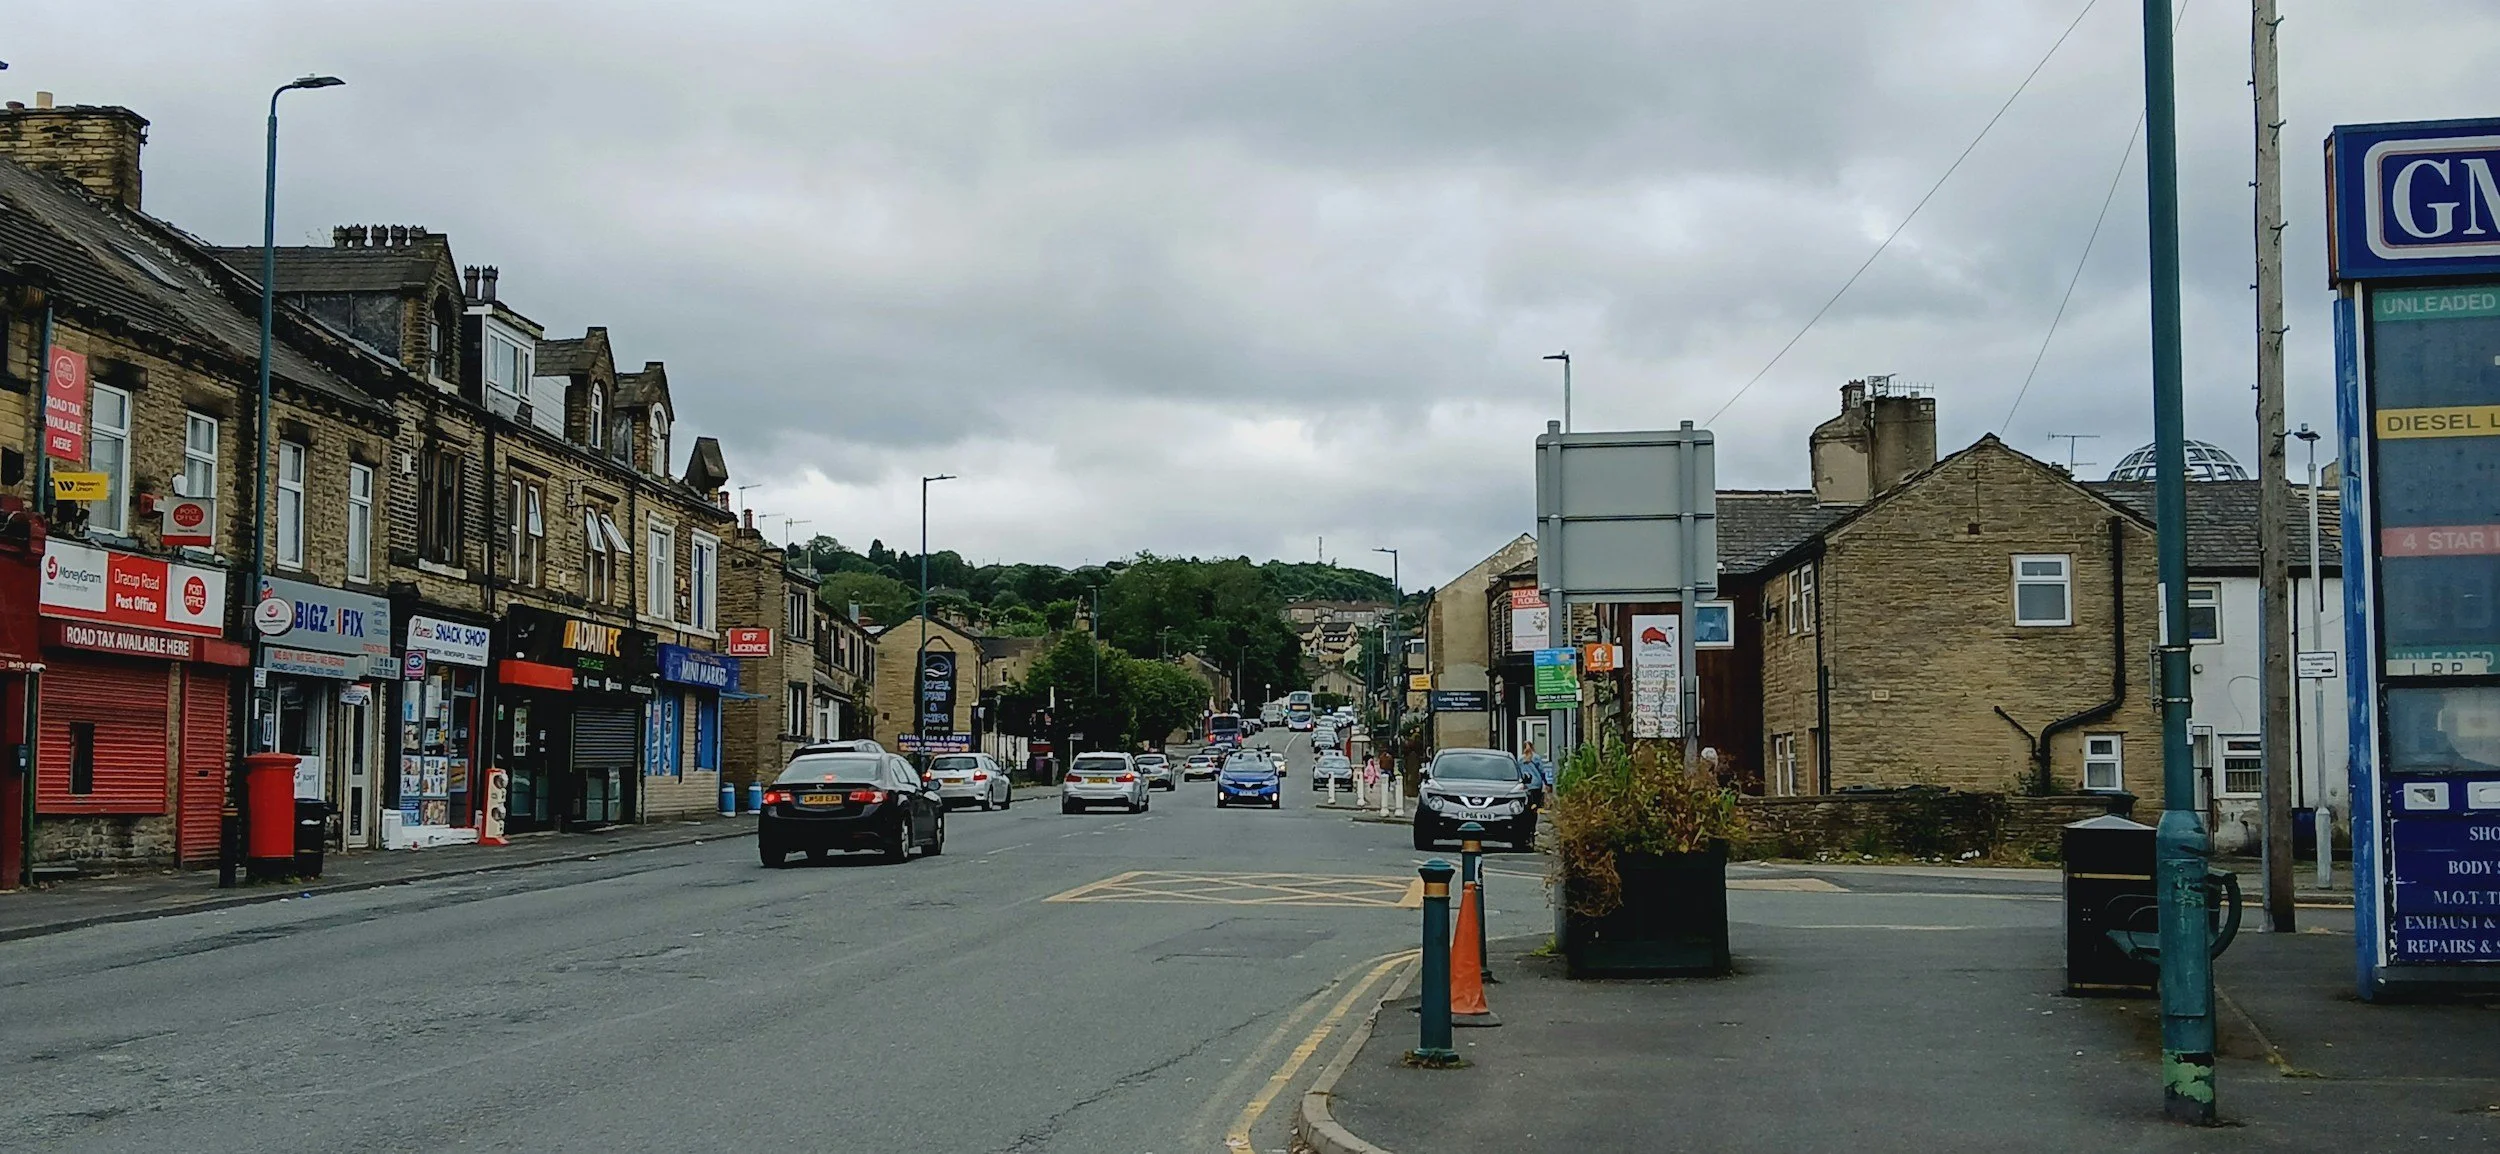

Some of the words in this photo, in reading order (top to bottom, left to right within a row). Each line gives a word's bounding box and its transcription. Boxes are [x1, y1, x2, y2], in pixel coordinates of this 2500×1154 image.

[2383, 293, 2496, 314] UNLEADED
[46, 395, 67, 412] ROAD
[68, 401, 81, 417] TAX
[2387, 414, 2481, 432] DIESEL
[52, 435, 72, 452] HERE
[2402, 533, 2418, 550] 4
[2428, 531, 2485, 550] STAR
[59, 566, 102, 584] MoneyGram
[114, 568, 140, 590] Dracup
[141, 574, 160, 591] Road
[187, 583, 203, 595] POST
[115, 593, 135, 609] Post
[134, 596, 158, 613] Office
[185, 594, 205, 608] OFFICE
[295, 601, 328, 633] BIGZ
[67, 626, 96, 646] ROAD
[97, 630, 116, 649] TAX
[116, 635, 165, 655] AVAILABLE
[166, 640, 190, 657] HERE
[435, 622, 462, 645] SNACK
[464, 628, 486, 648] SHOP
[573, 620, 606, 655] ADAM
[607, 628, 622, 658] FC
[742, 633, 758, 642] OFF
[733, 643, 767, 653] LICENCE
[681, 660, 700, 682] MINI
[699, 663, 728, 687] MARKET
[1639, 670, 1676, 678] URGERS
[2448, 860, 2493, 875] BODY
[2433, 890, 2484, 905] M.O.T.
[2404, 915, 2478, 930] EXHAUST
[2484, 917, 2496, 929] &
[2406, 939, 2476, 954] REPAIRS
[2480, 939, 2492, 953] &
